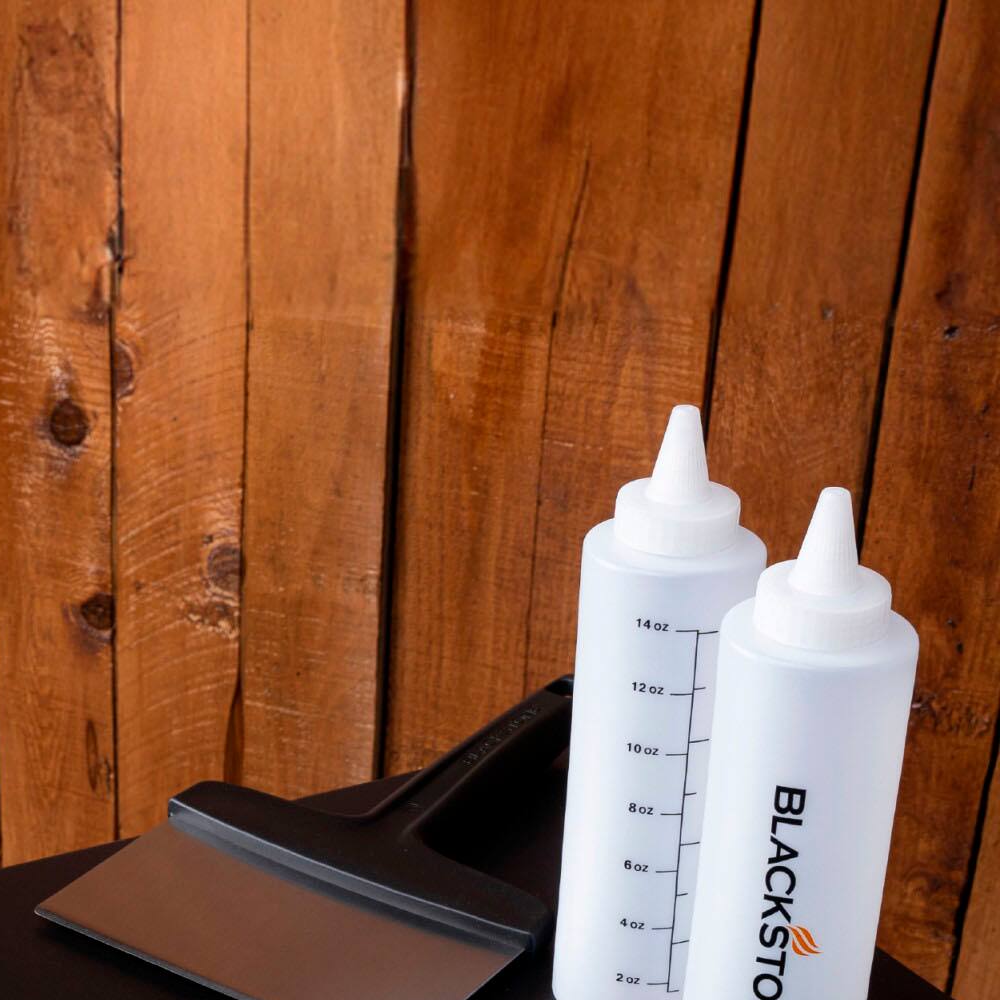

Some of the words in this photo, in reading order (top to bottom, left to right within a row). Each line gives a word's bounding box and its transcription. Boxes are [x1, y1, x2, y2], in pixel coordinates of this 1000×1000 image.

[635, 617, 652, 631] 14
[653, 621, 670, 632] oz
[631, 681, 647, 694] 12
[648, 685, 665, 696] oz
[626, 742, 642, 754] 10
[643, 746, 660, 756] oz
[628, 802, 638, 814] 8
[638, 805, 654, 816] oz
[623, 859, 632, 871] 6
[633, 862, 649, 873] oz
[619, 917, 628, 928] 4
[629, 920, 646, 931] oz
[615, 972, 624, 983] 2
[625, 975, 641, 985] oz
